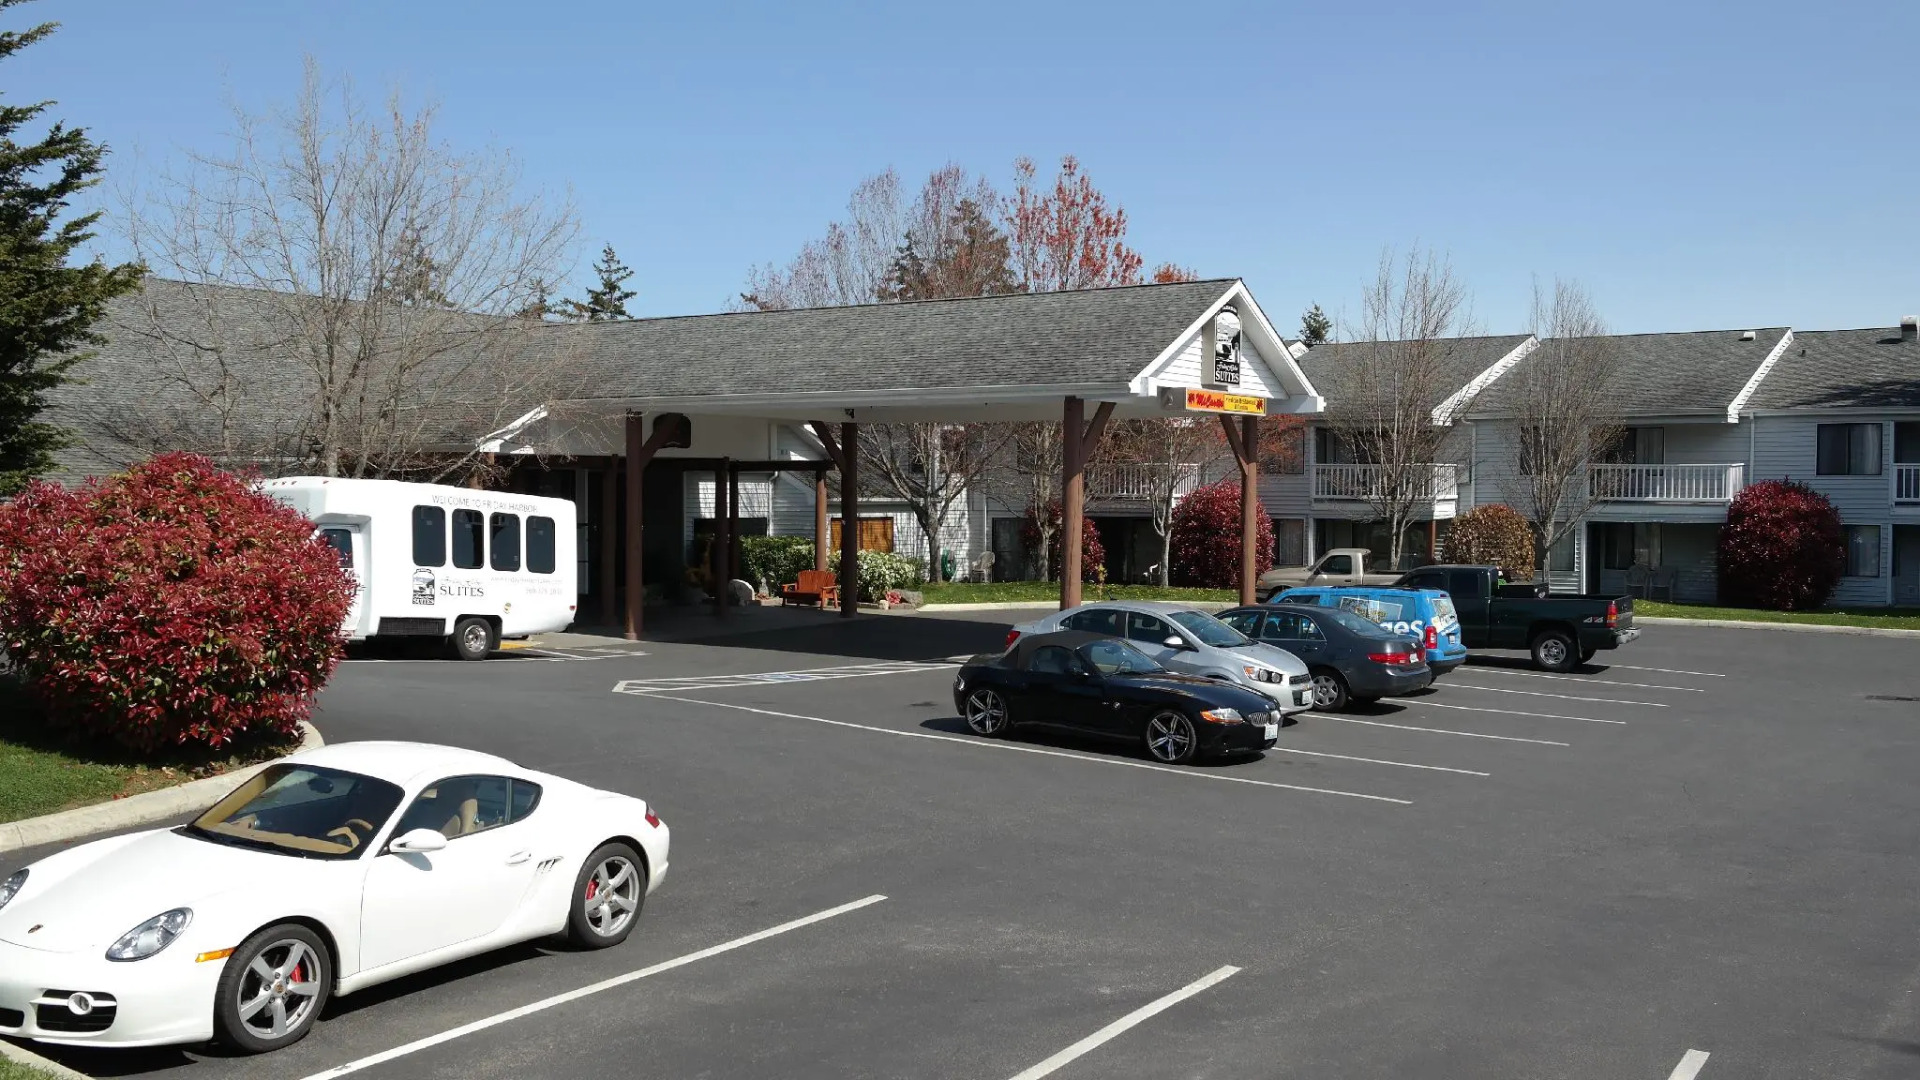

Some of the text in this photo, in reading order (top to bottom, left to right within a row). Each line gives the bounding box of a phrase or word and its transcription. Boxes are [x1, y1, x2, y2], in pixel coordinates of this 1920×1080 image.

[1215, 370, 1239, 383] SUITES
[432, 495, 470, 507] WELCOME
[482, 499, 507, 510] FRDAY
[508, 502, 538, 513] HARBOR
[440, 585, 484, 597] SUITES
